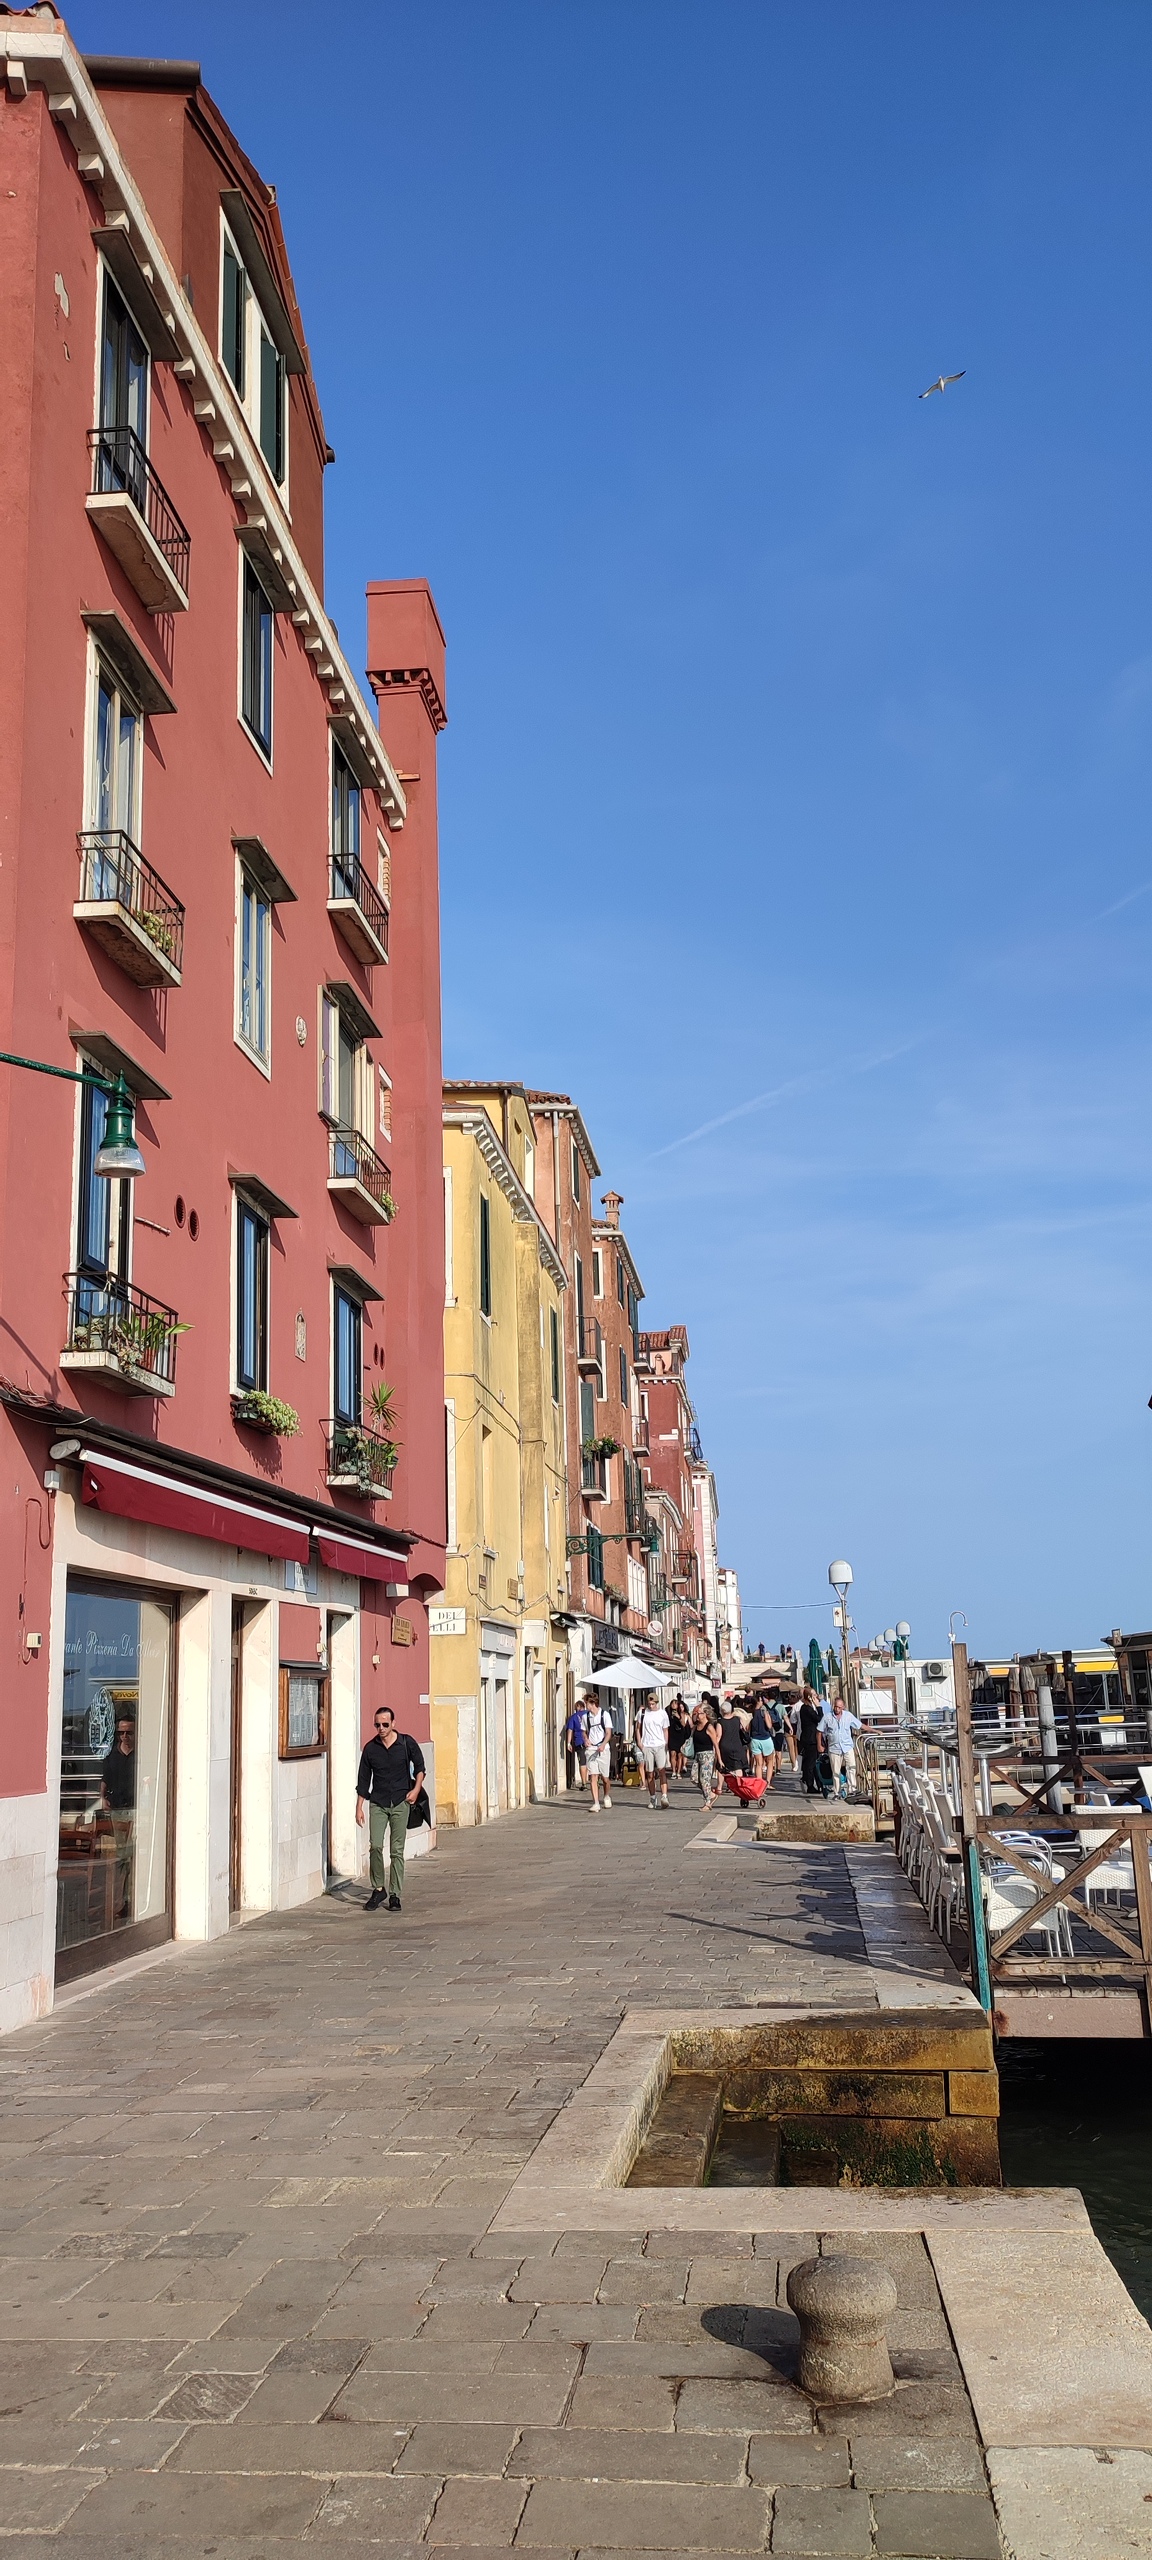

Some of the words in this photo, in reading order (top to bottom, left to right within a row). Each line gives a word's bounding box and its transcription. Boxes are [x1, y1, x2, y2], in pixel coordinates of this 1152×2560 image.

[432, 1623, 456, 1632] ELLI
[65, 1637, 83, 1654] ante
[86, 1630, 118, 1655] Pizzeria
[121, 1633, 134, 1657] Da
